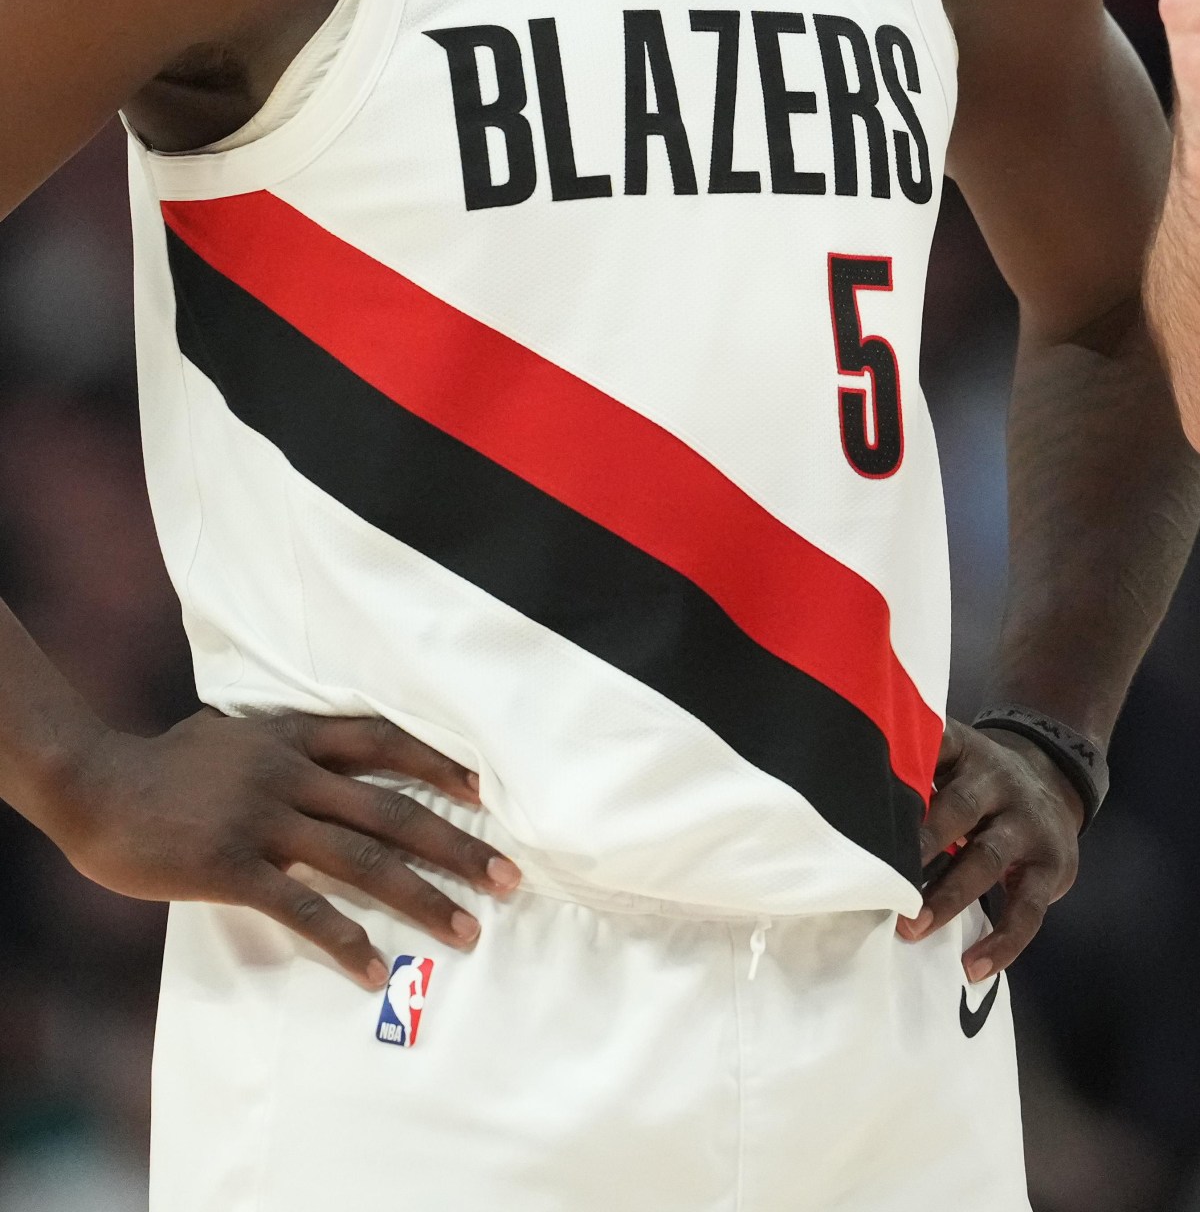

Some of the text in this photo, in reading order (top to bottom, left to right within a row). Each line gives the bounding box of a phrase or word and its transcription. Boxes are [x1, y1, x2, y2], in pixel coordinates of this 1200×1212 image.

[422, 10, 933, 211] BLAZERS
[827, 251, 904, 480] 5
[379, 1022, 402, 1042] NBA
